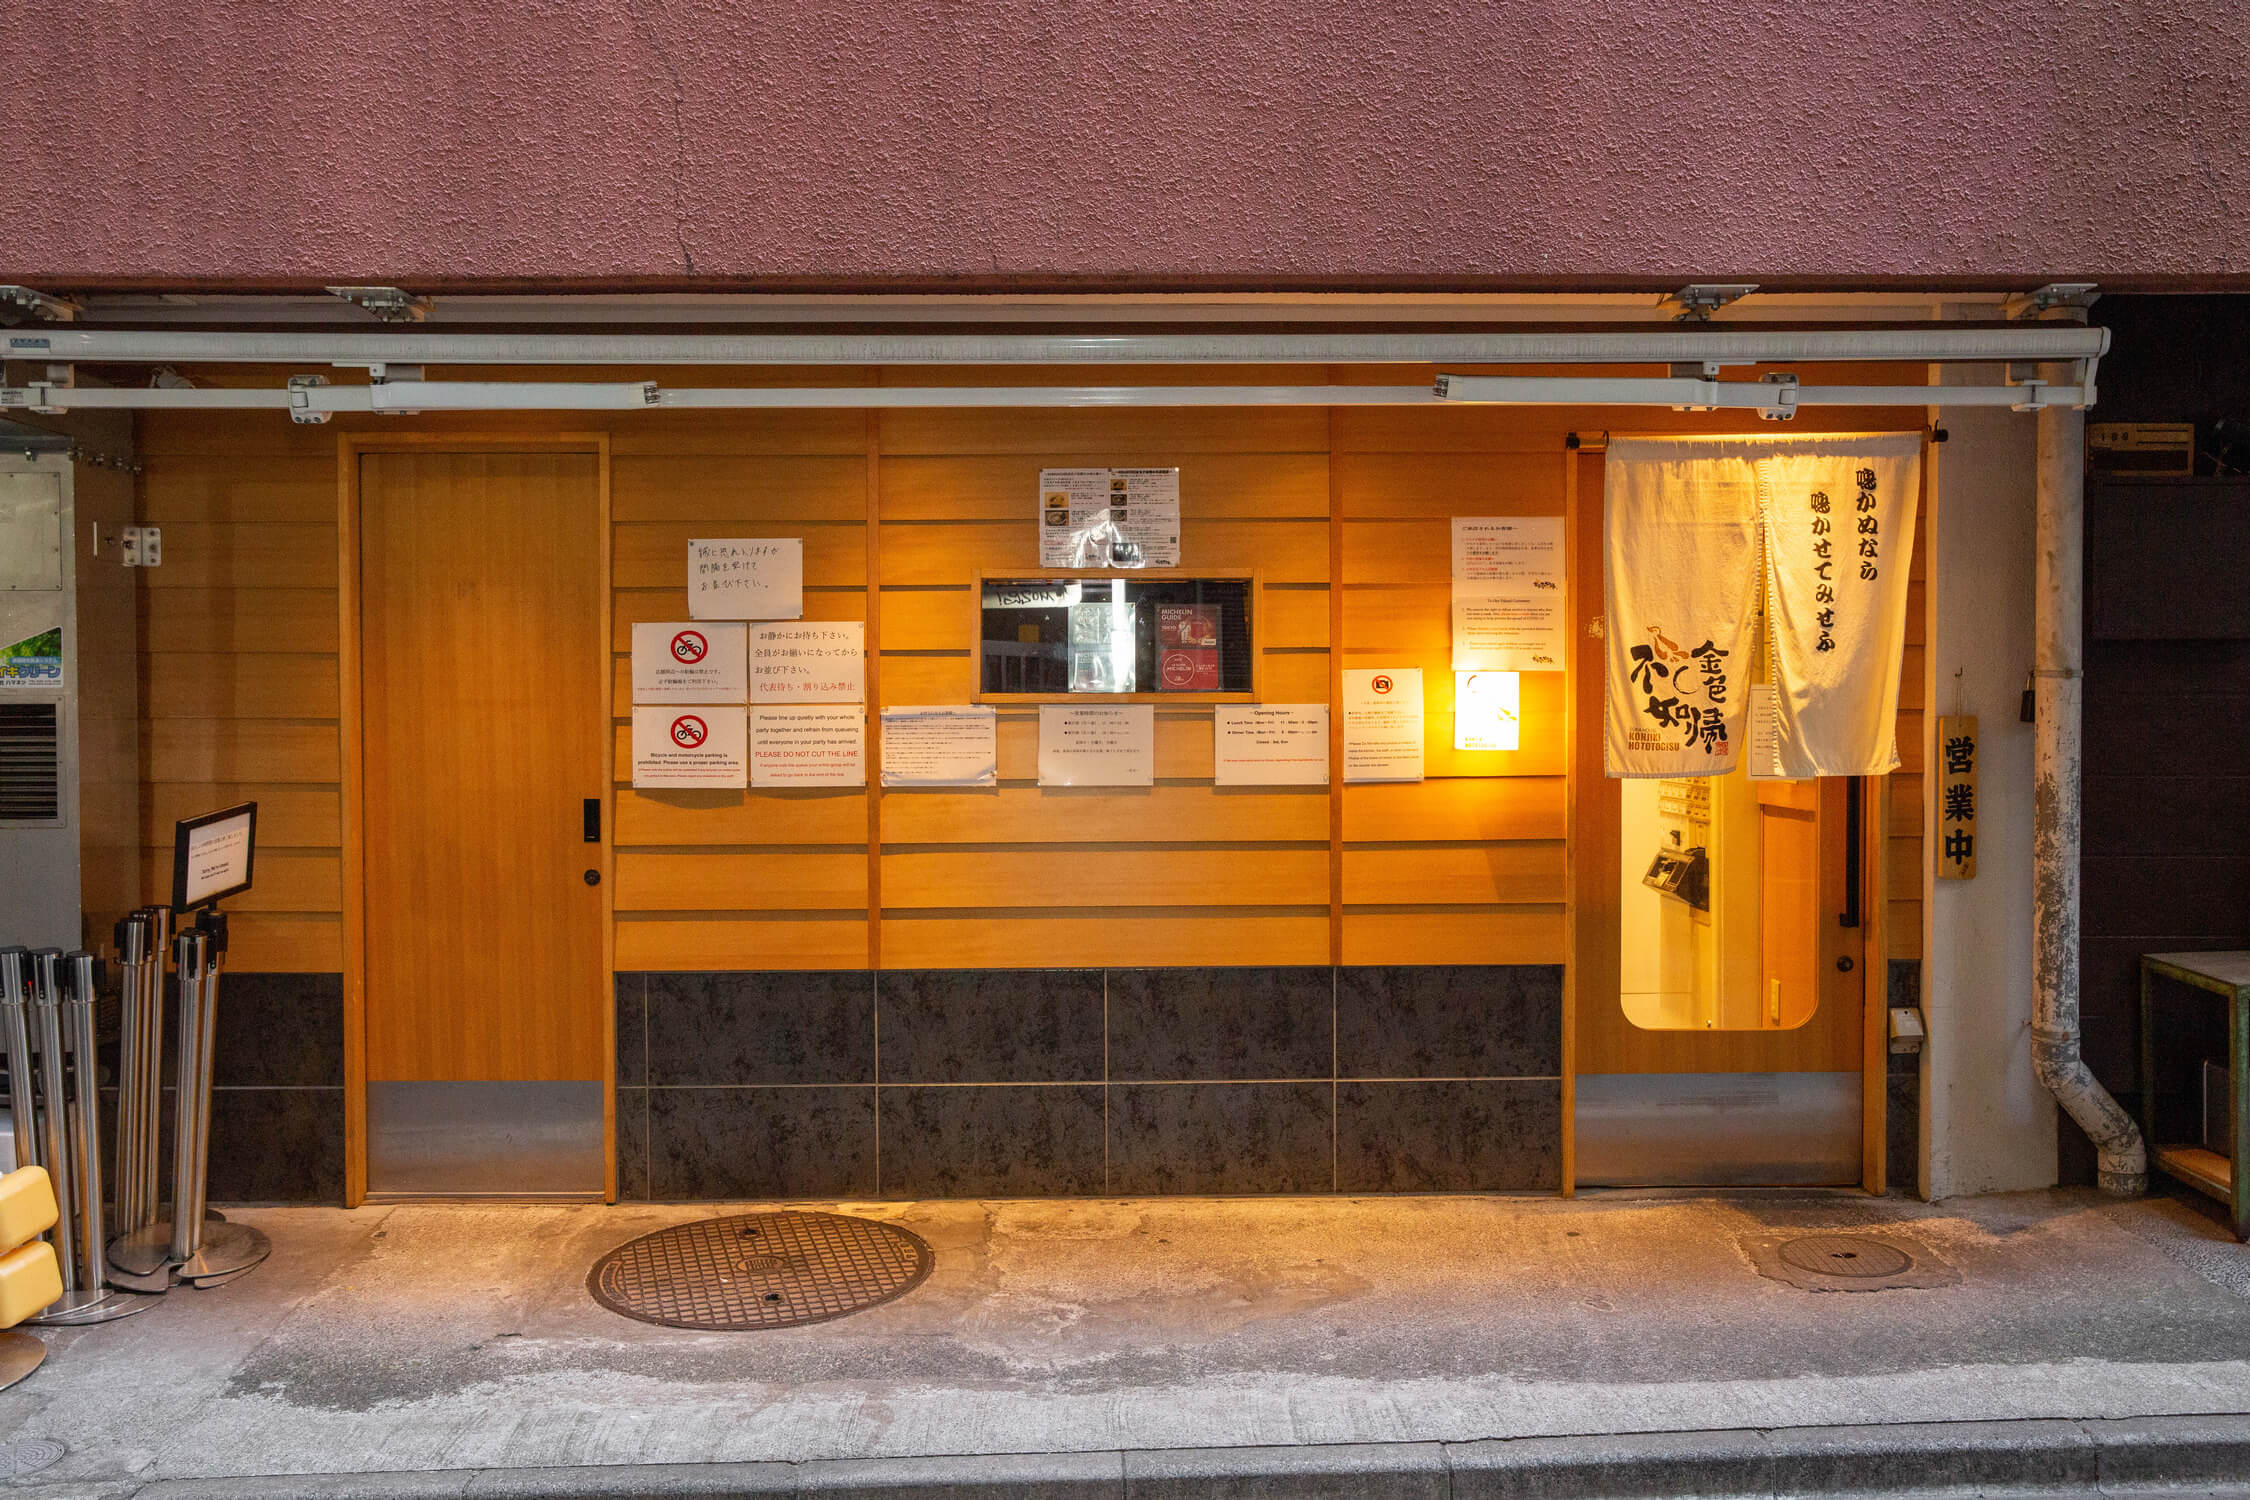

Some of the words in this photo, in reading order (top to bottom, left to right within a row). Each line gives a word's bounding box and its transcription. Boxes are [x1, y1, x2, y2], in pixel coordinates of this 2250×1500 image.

[760, 631, 849, 640] お静かにお待ち下さい。
[754, 648, 858, 657] 全員がお揃いになってから
[755, 665, 811, 675] お並び下さい。
[1691, 640, 1729, 703] 金色
[760, 682, 856, 692] 代表待ち・割り込み禁止
[1945, 736, 1976, 865] 営業中
